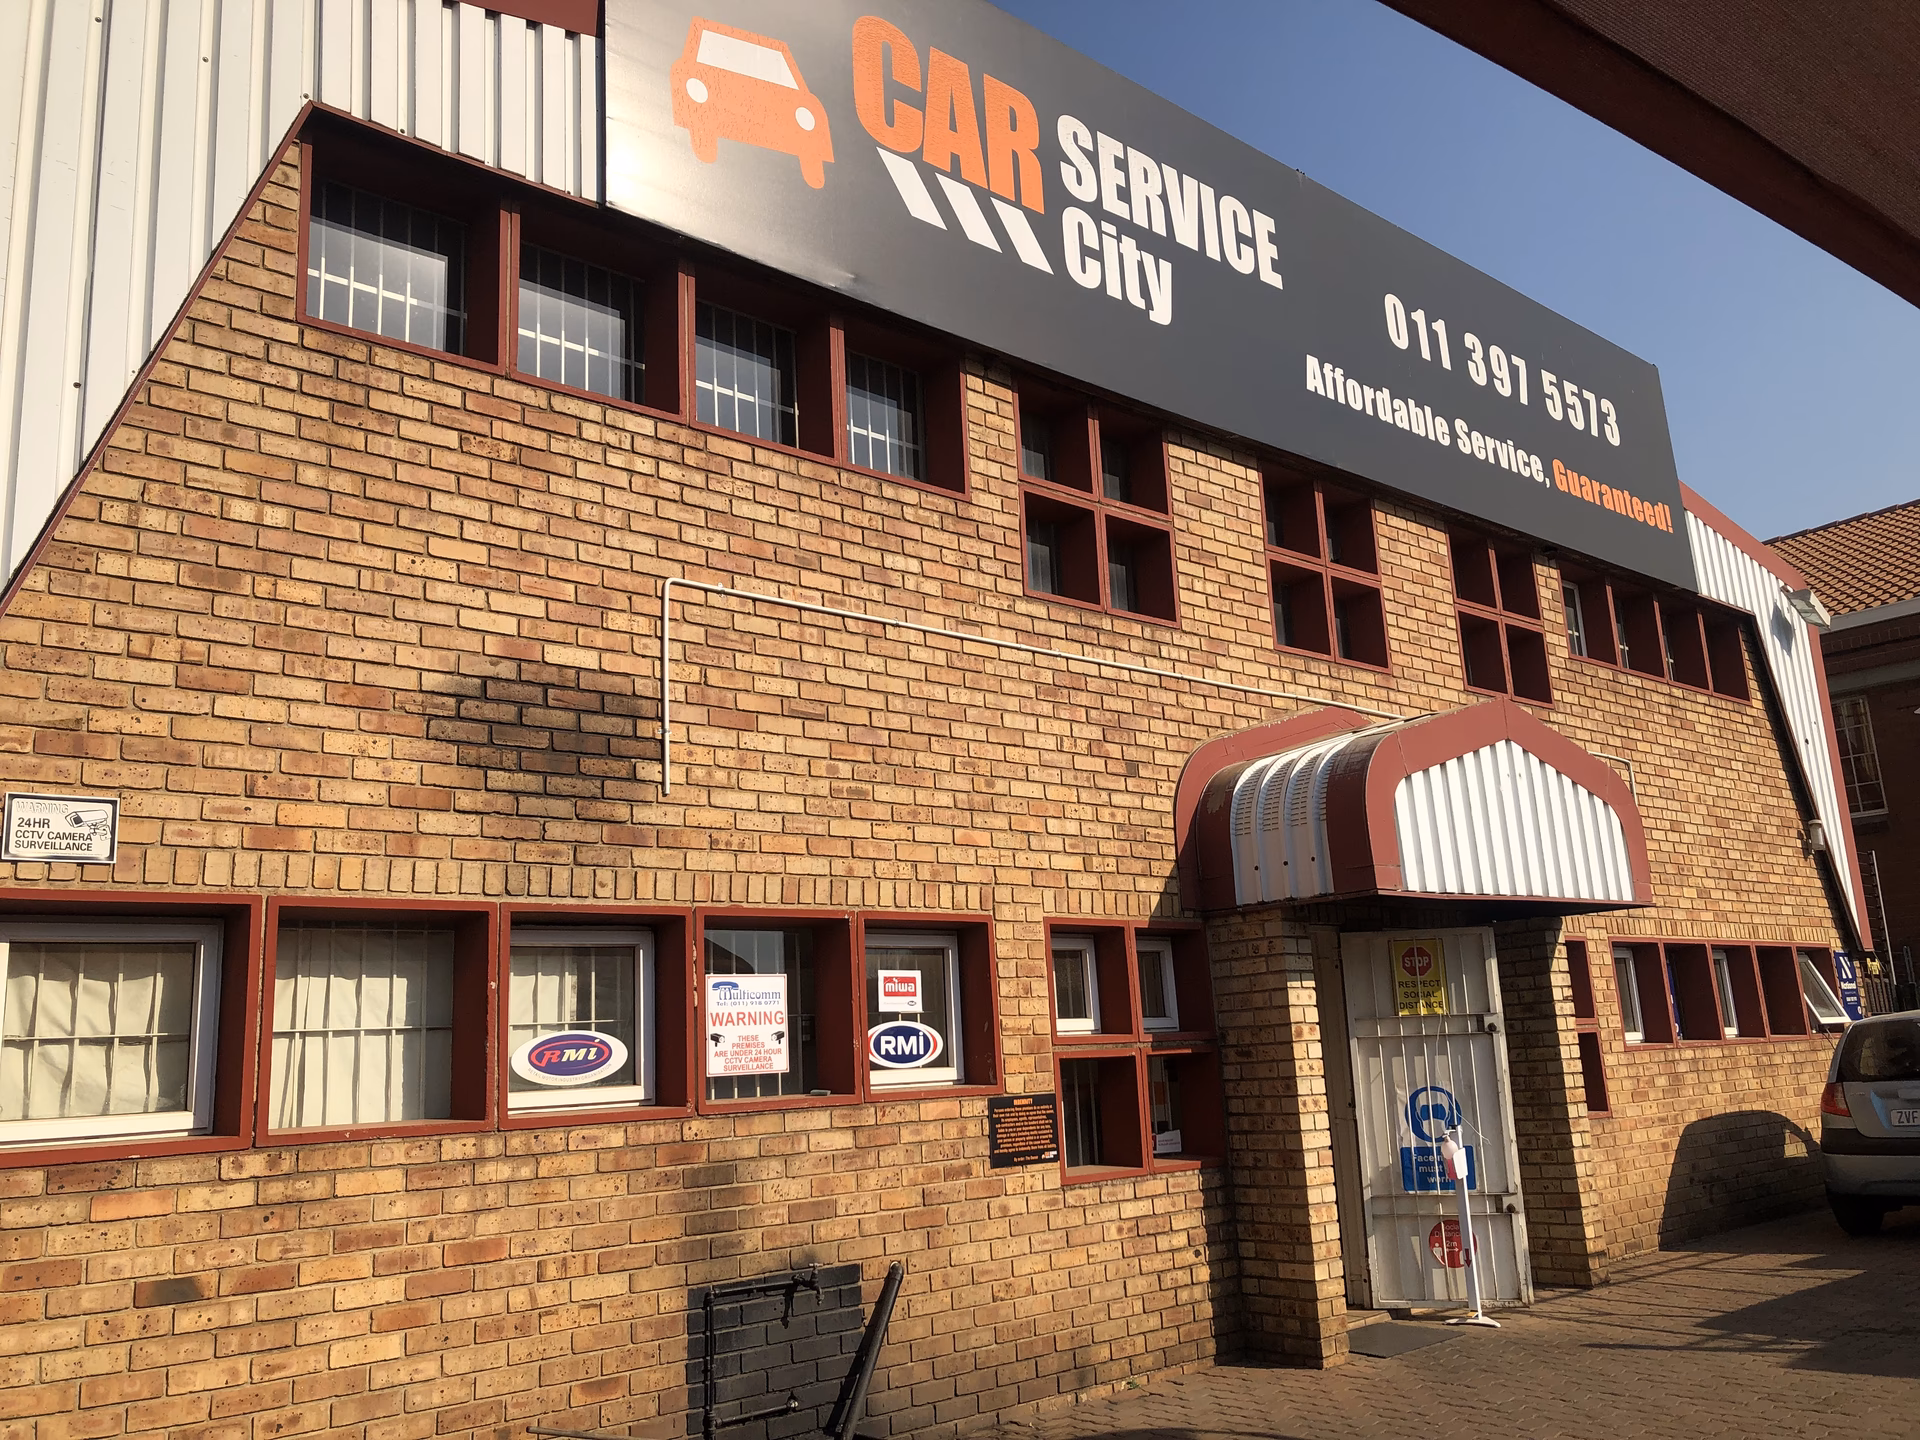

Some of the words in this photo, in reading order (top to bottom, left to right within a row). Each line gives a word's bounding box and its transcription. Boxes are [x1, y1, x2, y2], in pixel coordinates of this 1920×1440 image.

[852, 15, 1045, 215] CAR
[1055, 114, 1284, 291] SERVICE
[1061, 205, 1173, 326] City
[1384, 293, 1452, 371] 011
[1464, 332, 1529, 406] 397
[1541, 368, 1621, 447] 5573
[1305, 353, 1451, 447] Affordable
[1454, 417, 1551, 489] Service,
[1551, 458, 1674, 534] Guaranteed!
[16, 800, 69, 815] WARNING
[17, 817, 51, 829] 24HR
[15, 829, 44, 839] CCTV
[47, 831, 93, 841] CAMERA
[14, 839, 93, 851] SURVEILLANCE
[1404, 956, 1429, 967] STOP
[885, 977, 915, 993] miwa
[1398, 979, 1441, 988] RESPECT
[719, 987, 781, 1001] Multicomm
[710, 1010, 785, 1027] WARNING
[737, 1034, 760, 1042] THESE
[880, 1031, 925, 1056] RMi
[731, 1041, 765, 1049] PREMISES
[714, 1050, 728, 1058] ARE
[729, 1049, 753, 1057] UNDER
[754, 1048, 762, 1056] 24
[763, 1047, 782, 1055] HOUR
[724, 1057, 743, 1065] CCTV
[744, 1055, 773, 1063] CAMERA
[723, 1063, 774, 1072] SURVEILLANCE
